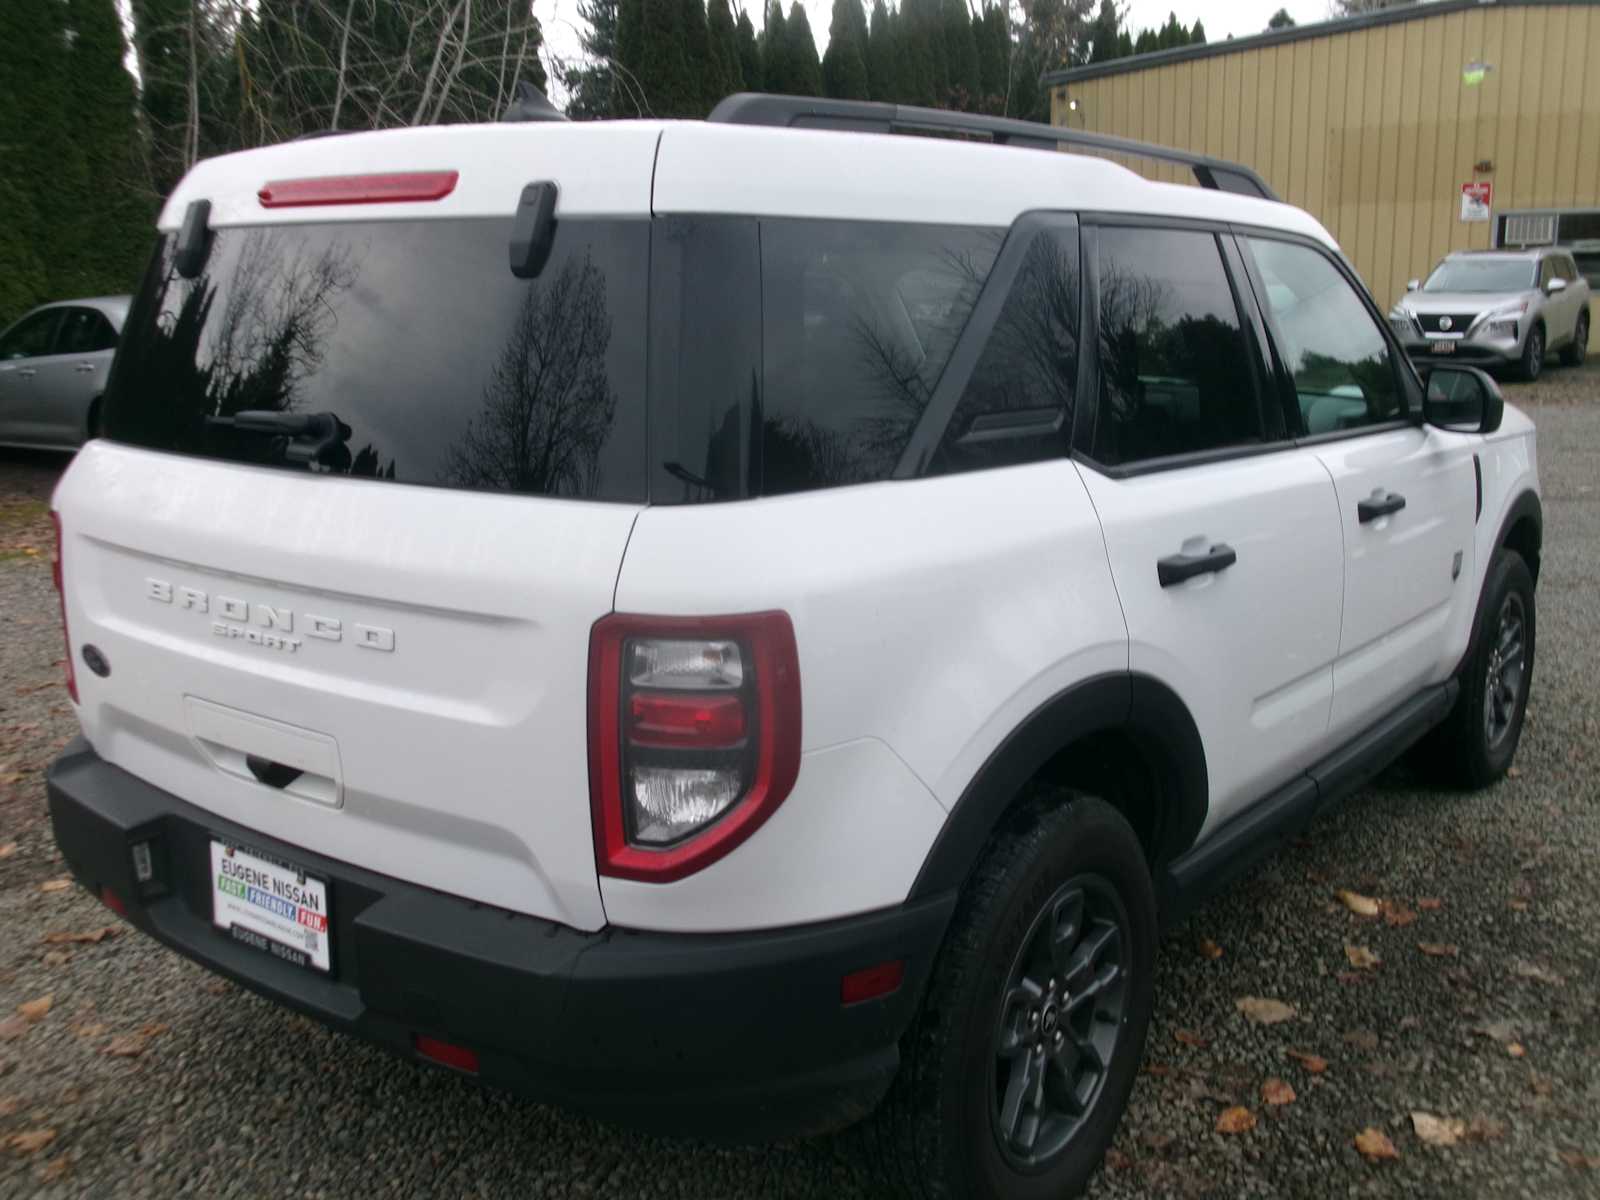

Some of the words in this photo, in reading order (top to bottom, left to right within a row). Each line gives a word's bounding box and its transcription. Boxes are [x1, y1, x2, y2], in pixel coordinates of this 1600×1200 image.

[145, 577, 396, 652] BRONCO
[212, 622, 302, 653] SPORT
[221, 858, 270, 891] EUGENE
[272, 877, 319, 911] NISSAN
